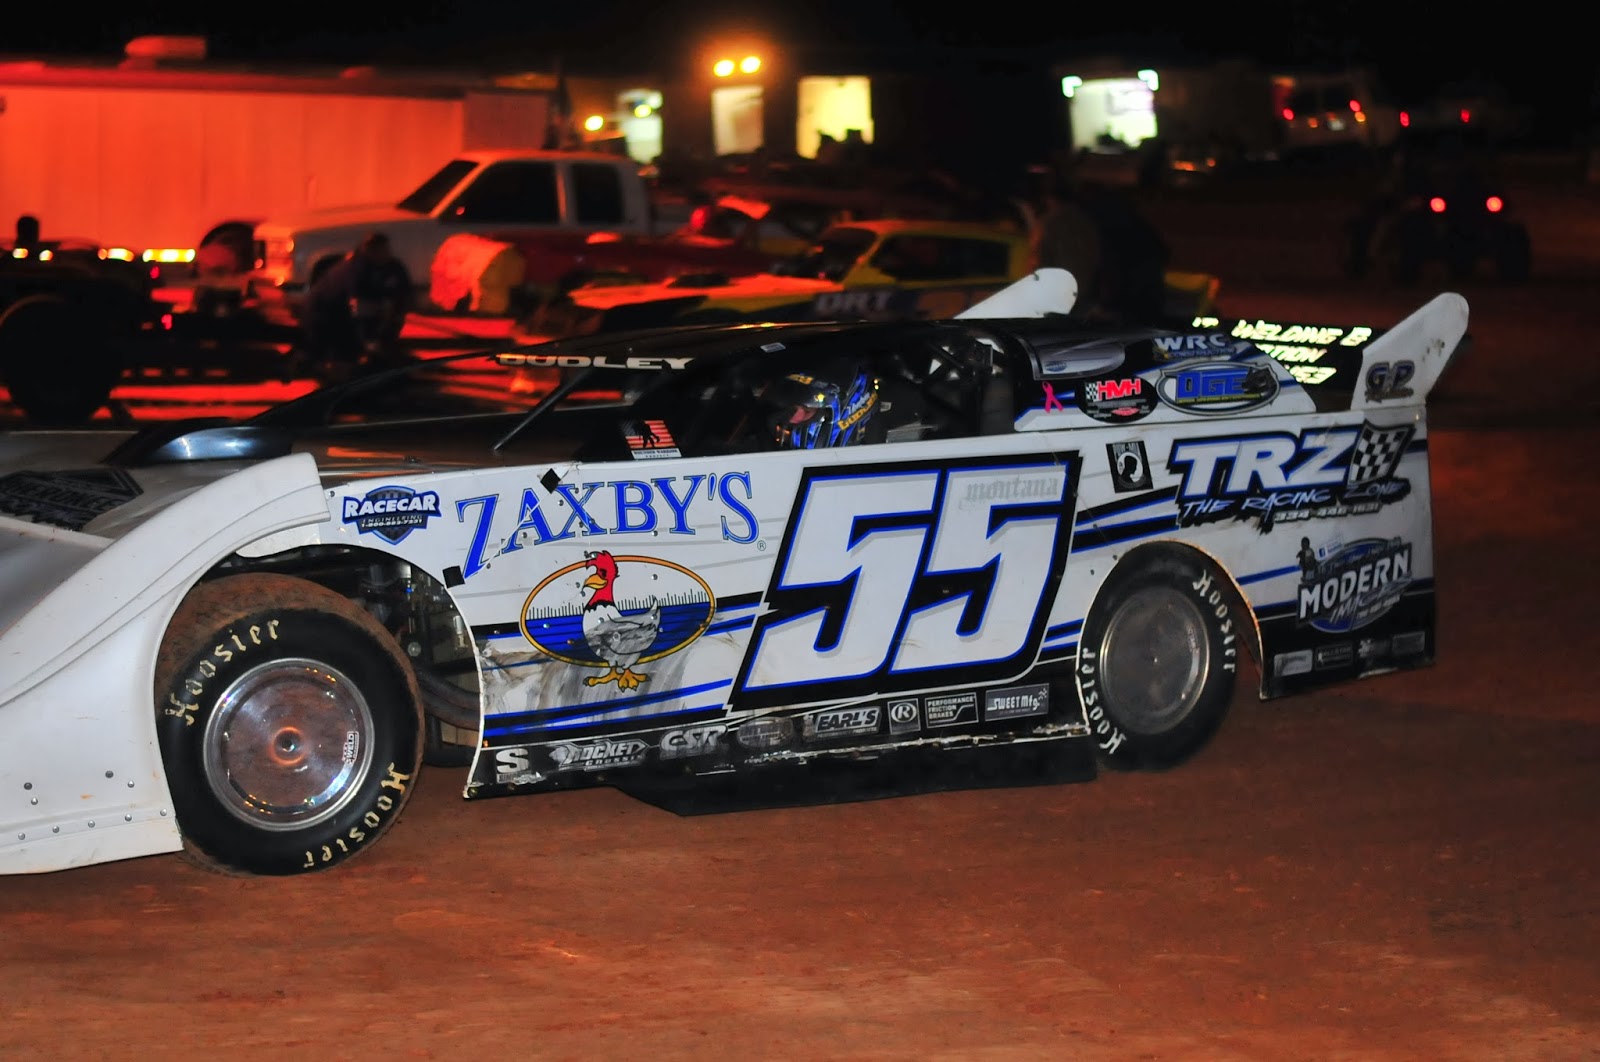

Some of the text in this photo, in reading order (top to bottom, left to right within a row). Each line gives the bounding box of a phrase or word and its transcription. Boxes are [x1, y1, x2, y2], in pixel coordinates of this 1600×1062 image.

[1155, 333, 1226, 350] WRC
[1232, 320, 1343, 345] WELDING
[496, 353, 695, 370] DUDLEY
[1174, 429, 1358, 498] TRZ
[345, 494, 436, 518] RACECAR
[1184, 479, 1407, 521] THE RACING ZONE
[455, 471, 759, 579] ZAXBY'S
[742, 460, 1069, 692] 55
[1299, 549, 1410, 619] MODERN
[1192, 569, 1237, 673] Hoosier
[164, 618, 280, 727] Hoosier
[927, 696, 974, 707] PERFORMANCE
[928, 704, 957, 713] FRICTION
[1081, 647, 1127, 754] Hoosier
[818, 709, 877, 731] EARL'S
[928, 711, 954, 720] BRAKES
[346, 733, 355, 759] WELD
[495, 748, 529, 774] S
[303, 762, 411, 868] Hoosier
